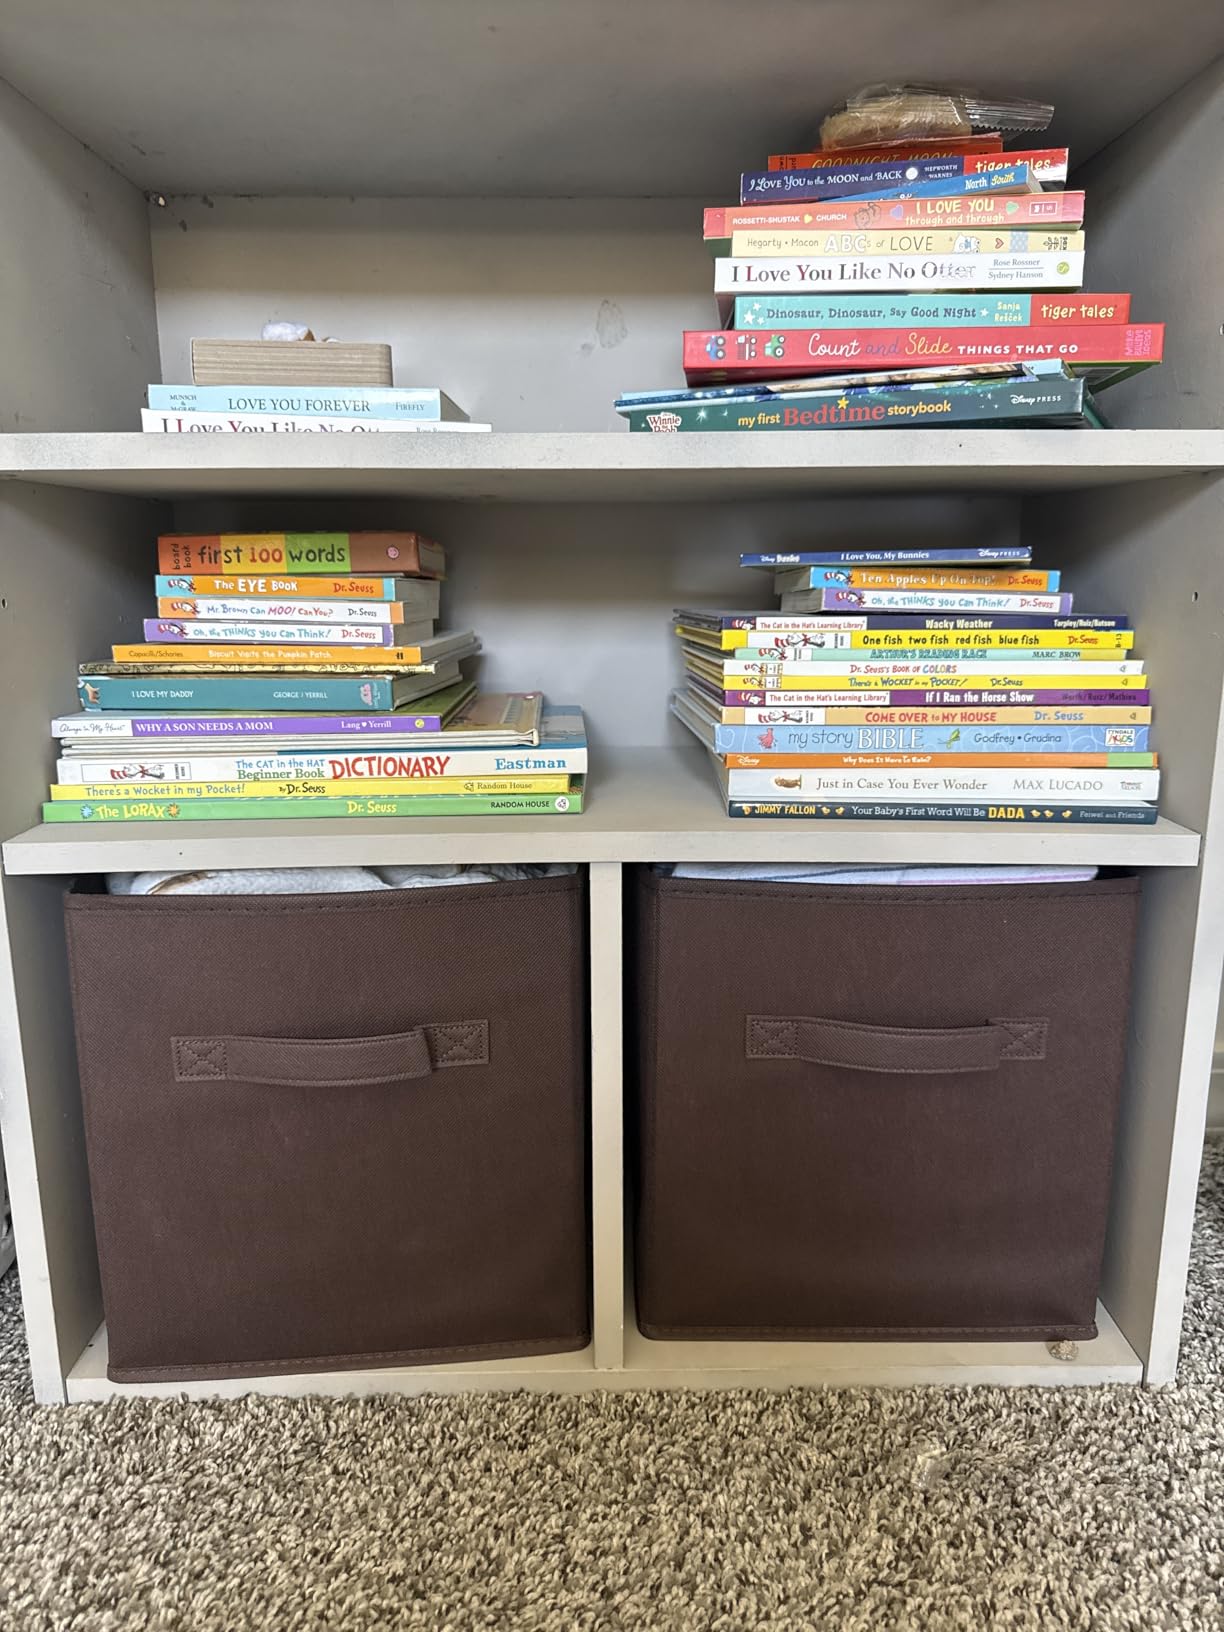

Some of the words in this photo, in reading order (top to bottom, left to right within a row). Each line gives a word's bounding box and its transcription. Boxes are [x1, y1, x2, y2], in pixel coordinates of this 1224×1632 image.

[749, 180, 756, 191] I
[757, 178, 781, 191] LOVE
[783, 176, 806, 190] YOU
[827, 173, 859, 185] MOON
[860, 172, 873, 182] and
[874, 170, 903, 180] BACK
[965, 177, 988, 190] North
[991, 171, 1015, 186] South
[916, 202, 921, 214] I
[927, 200, 961, 214] LOVE
[968, 199, 995, 213] YOU
[816, 213, 847, 222] CHURCH
[905, 215, 942, 227] through
[946, 214, 963, 224] and
[966, 212, 1005, 225] through
[747, 238, 781, 249] Hegarty
[792, 238, 819, 247] Macon
[993, 258, 1010, 267] Rose
[1012, 258, 1041, 267] Rossner
[732, 266, 740, 282] I
[745, 265, 790, 282] Love
[796, 264, 832, 281] You
[838, 262, 882, 281] Like
[888, 262, 916, 279] No
[921, 261, 977, 279] Otter
[988, 270, 1014, 281] Sydney
[1015, 270, 1044, 279] Hanson
[996, 301, 1020, 311] Sanja
[1041, 304, 1076, 320] tiger
[1080, 304, 1115, 318] tales
[767, 308, 825, 320] Dinosaur,
[828, 307, 886, 319] Dinosaur,
[889, 307, 907, 318] Say
[910, 306, 938, 317] Good
[943, 306, 977, 319] Night
[808, 333, 861, 357] Count
[866, 341, 900, 355] and
[904, 332, 952, 356] Slide
[958, 346, 1010, 355] THINGS
[1016, 345, 1053, 354] THAT
[1059, 344, 1079, 354] GO
[228, 398, 267, 410] LOVE
[269, 398, 301, 411] YOU
[304, 398, 371, 412] FOREVER
[1010, 394, 1035, 406] Disney
[1037, 395, 1062, 403] PRESS
[395, 402, 425, 411] FIREFLY
[737, 416, 755, 429] my
[757, 413, 780, 425] first
[784, 402, 886, 428] Bedtime
[888, 400, 951, 417] storybook
[171, 544, 180, 570] board
[181, 545, 191, 568] book
[198, 545, 243, 564] first
[250, 548, 283, 563] 100
[289, 544, 345, 563] words
[977, 549, 999, 558] Disney
[333, 583, 347, 593] Dr.
[348, 582, 374, 594] Seuss
[925, 619, 954, 630] Wacky
[956, 619, 993, 629] Weather
[863, 635, 881, 644] One
[883, 635, 903, 644] fish
[909, 636, 927, 644] two
[930, 635, 949, 644] fish
[955, 636, 970, 644] red
[974, 635, 992, 644] fish
[999, 635, 1019, 644] blue
[1021, 635, 1039, 644] fish
[869, 649, 916, 659] ARTHUR'S
[918, 649, 960, 659] READING
[962, 649, 988, 659] RACE
[136, 690, 155, 698] LOVE
[170, 690, 194, 698] DADDY
[305, 691, 328, 699] YERRILL
[816, 694, 832, 702] Hat's
[834, 694, 862, 702] Learning
[864, 694, 887, 702] Library
[925, 692, 934, 702] If
[936, 693, 940, 702] I
[943, 693, 960, 702] Ran
[964, 692, 978, 702] the
[981, 692, 1006, 703] Horse
[1009, 692, 1034, 702] Show
[865, 712, 895, 723] COME
[898, 712, 928, 722] OVER
[941, 712, 958, 722] MY
[960, 712, 997, 722] HOUSE
[1034, 711, 1051, 720] Dr.
[1054, 711, 1084, 720] Seuss
[136, 723, 162, 732] WHY
[173, 723, 196, 731] SON
[197, 722, 234, 731] NEEDS
[244, 722, 273, 730] MOM
[341, 721, 361, 730] Lang
[368, 720, 392, 728] Yerrill
[788, 732, 808, 748] my
[812, 729, 854, 749] story
[858, 728, 925, 749] BIBLE
[974, 732, 1015, 745] Godfrey
[1024, 733, 1061, 743] Grudina
[236, 760, 254, 769] The
[256, 759, 274, 768] CAT
[276, 759, 285, 768] in
[288, 759, 305, 768] the
[307, 759, 326, 767] HAT
[495, 758, 567, 770] Eastman
[736, 755, 760, 765] Disney
[329, 756, 450, 780] DICTIONARY
[237, 769, 292, 781] Beginner
[294, 768, 326, 778] Book
[477, 782, 507, 790] Random
[816, 777, 839, 790] Just
[843, 779, 853, 788] in
[857, 779, 884, 789] Case
[888, 779, 909, 789] You
[913, 779, 939, 790] Ever
[943, 779, 988, 790] Wonder
[1013, 779, 1044, 790] MAX
[1049, 779, 1103, 791] LUCADO
[96, 805, 119, 819] The
[122, 804, 167, 819] LORAX
[347, 801, 364, 814] Dr.
[367, 801, 397, 814] Seuss
[754, 805, 782, 814] JIMMY
[785, 805, 816, 814] FALLON
[851, 806, 872, 815] Your
[874, 806, 904, 817] Baby's
[905, 807, 925, 816] First
[927, 808, 953, 816] Word
[954, 808, 972, 816] Will
[973, 808, 986, 816] Be
[988, 807, 1025, 819] DADA
